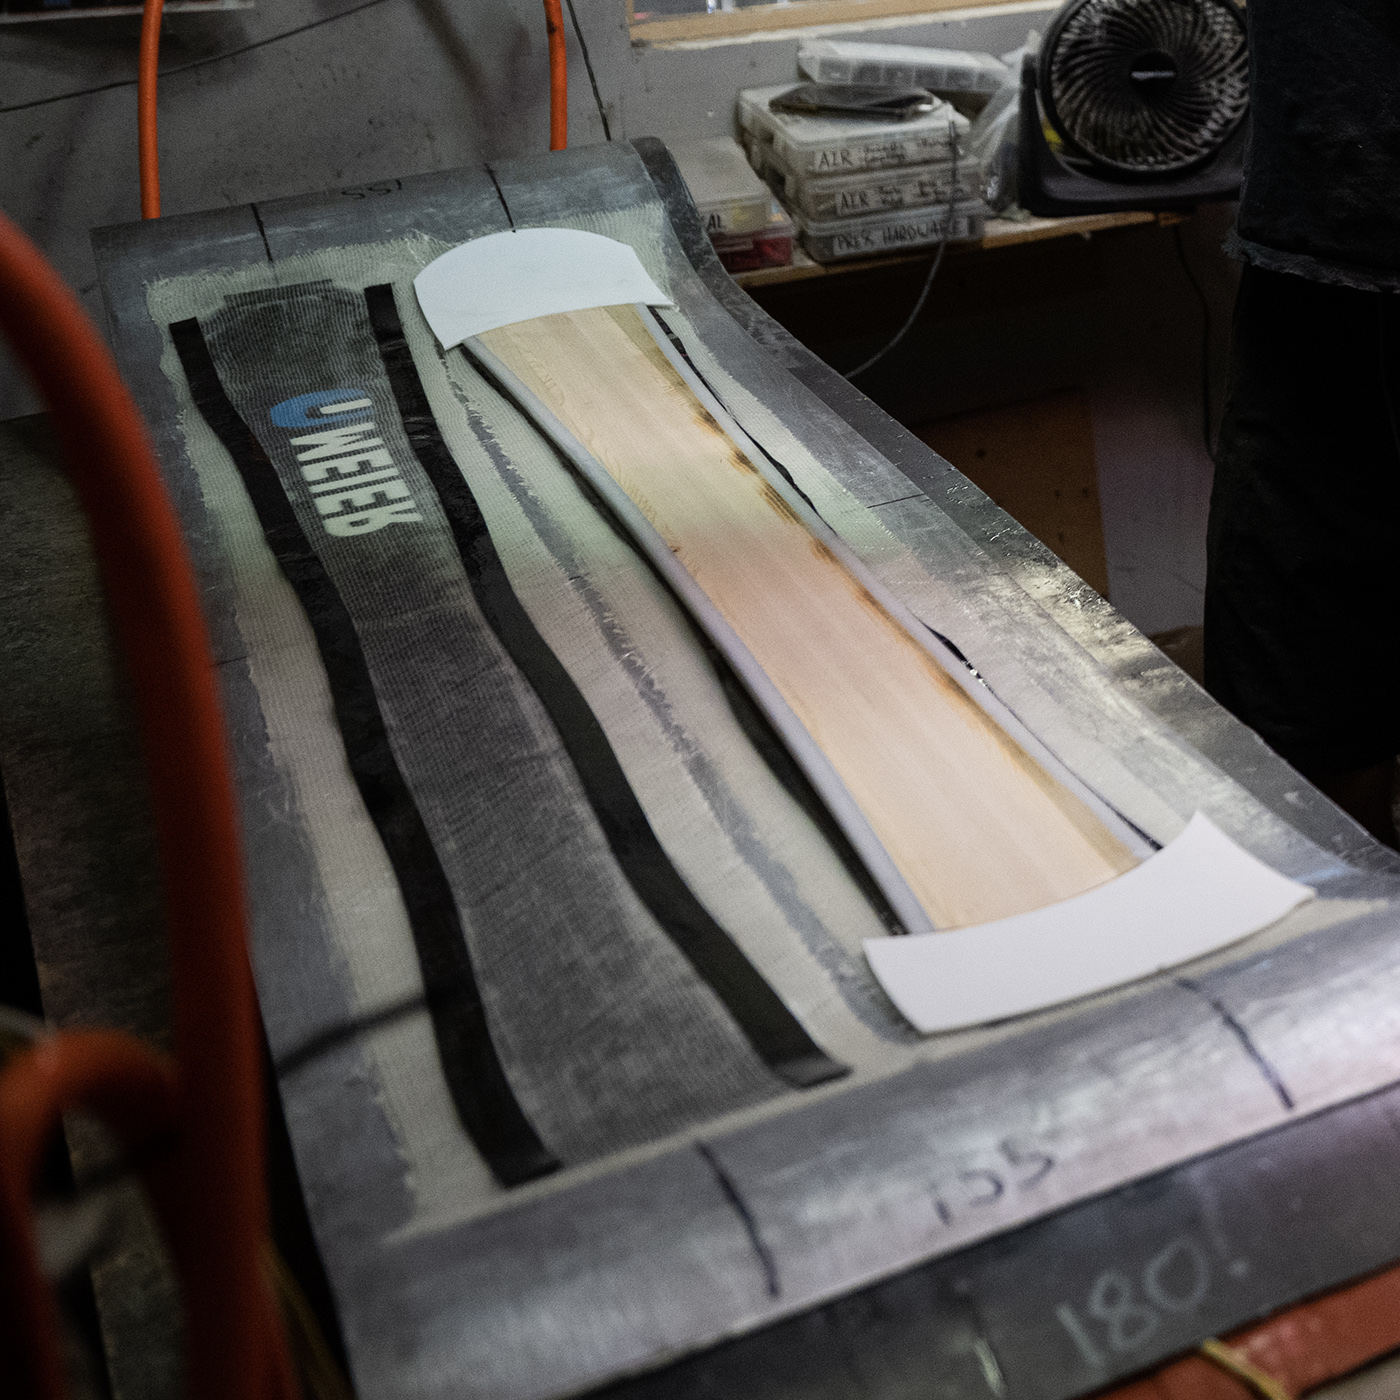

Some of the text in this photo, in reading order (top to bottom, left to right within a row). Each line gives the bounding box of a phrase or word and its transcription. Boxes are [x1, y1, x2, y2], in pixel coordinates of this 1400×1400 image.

[818, 149, 854, 170] AIR
[838, 190, 870, 212] AIR
[290, 421, 424, 538] MEIER
